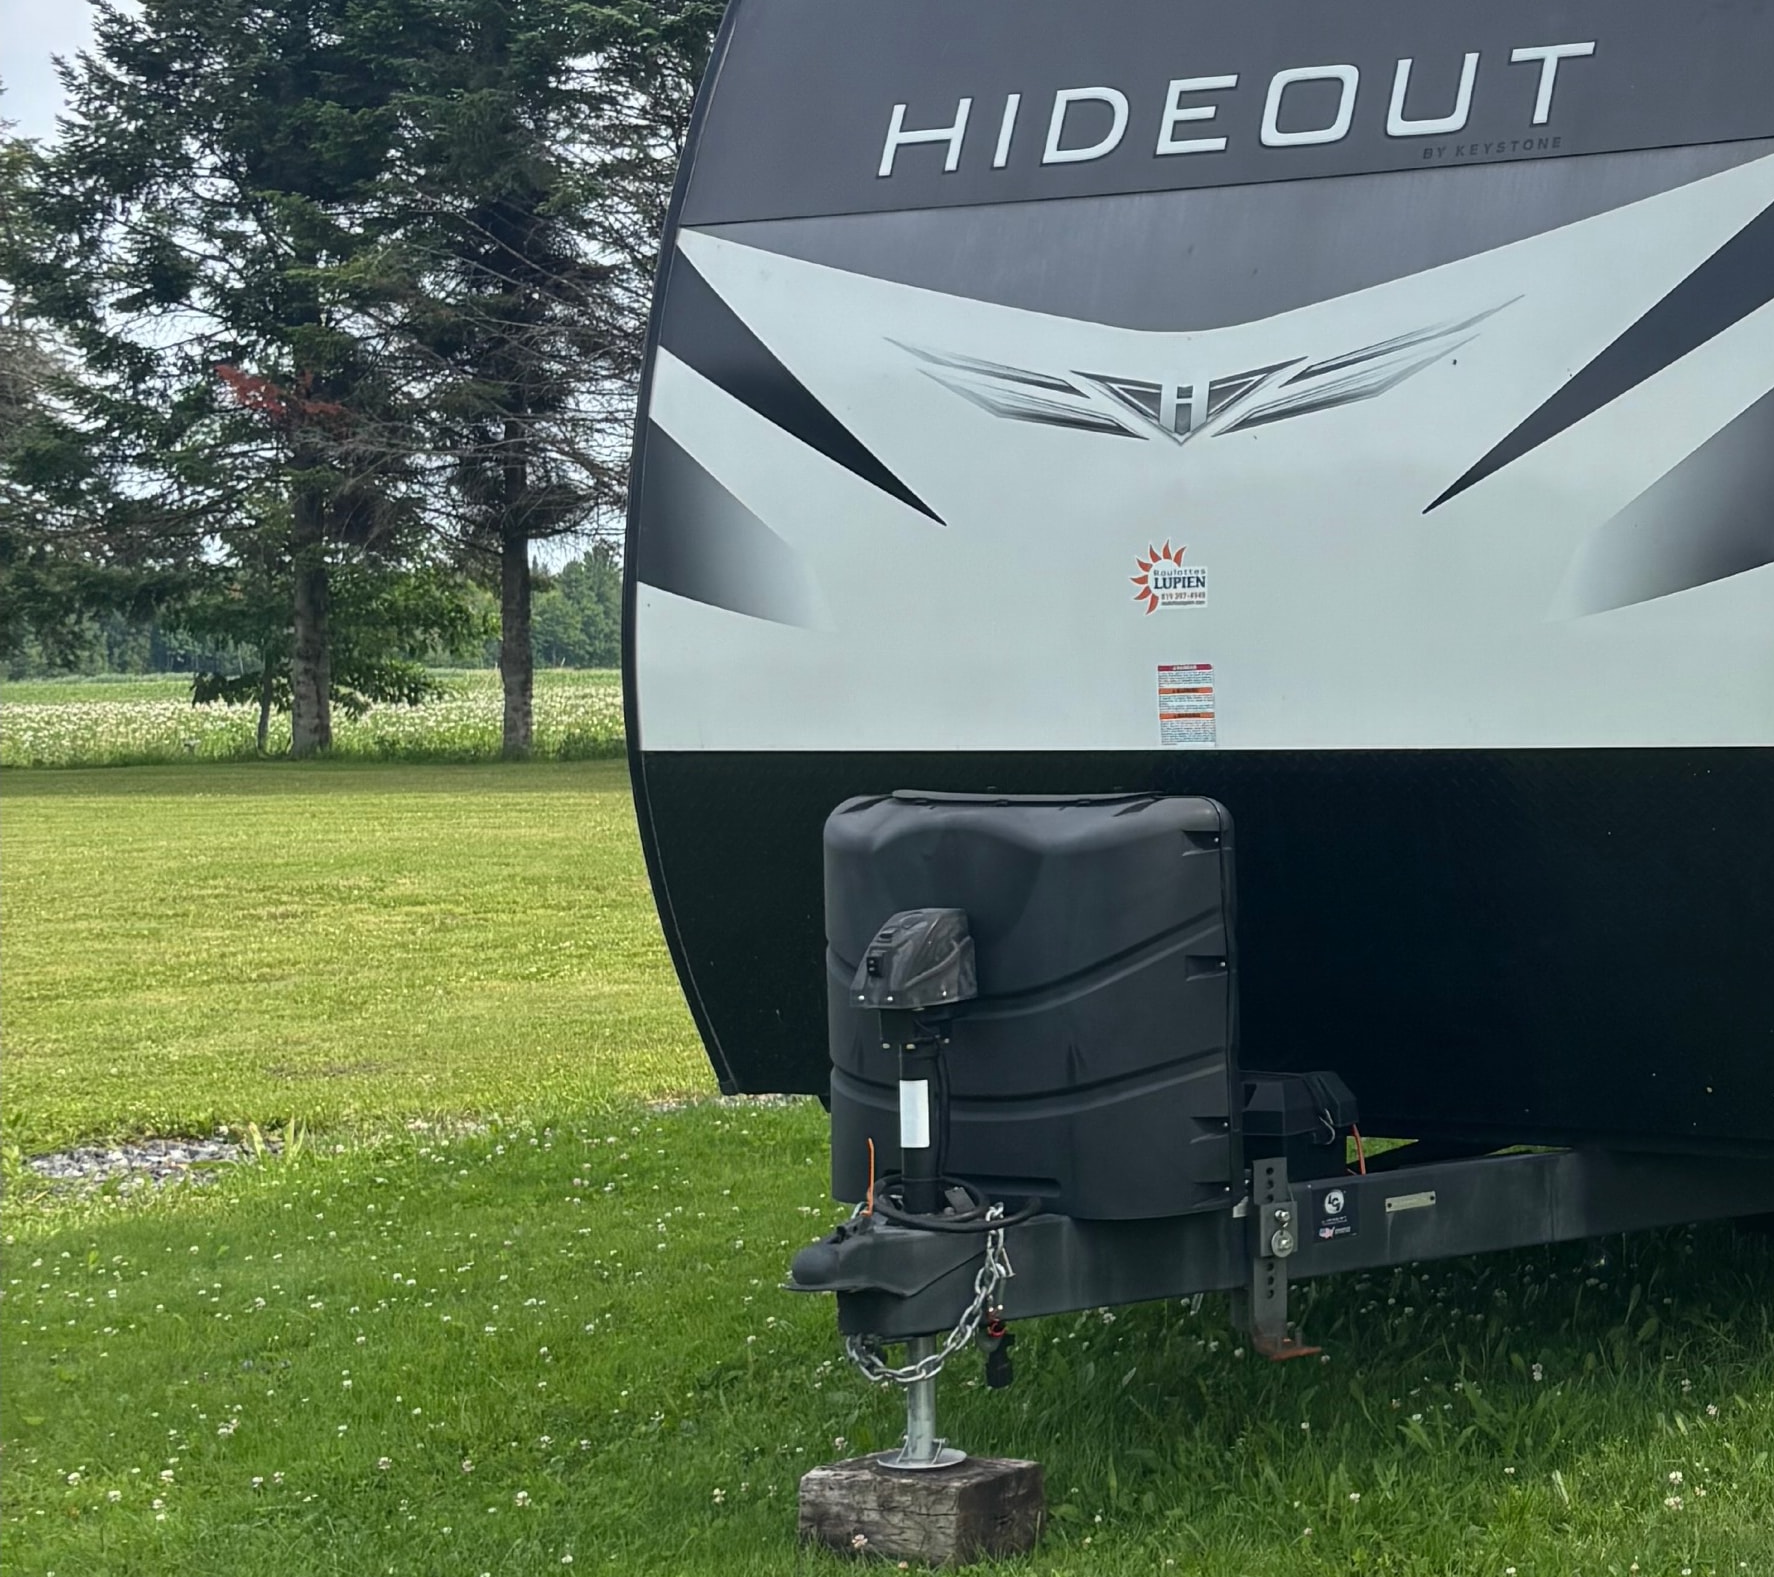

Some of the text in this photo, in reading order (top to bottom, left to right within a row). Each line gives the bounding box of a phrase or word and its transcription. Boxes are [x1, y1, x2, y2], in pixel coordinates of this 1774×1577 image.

[875, 40, 1597, 179] HIDEOUT
[1422, 136, 1563, 160] BY KEYSTONE
[1153, 575, 1206, 590] LUPIEN
